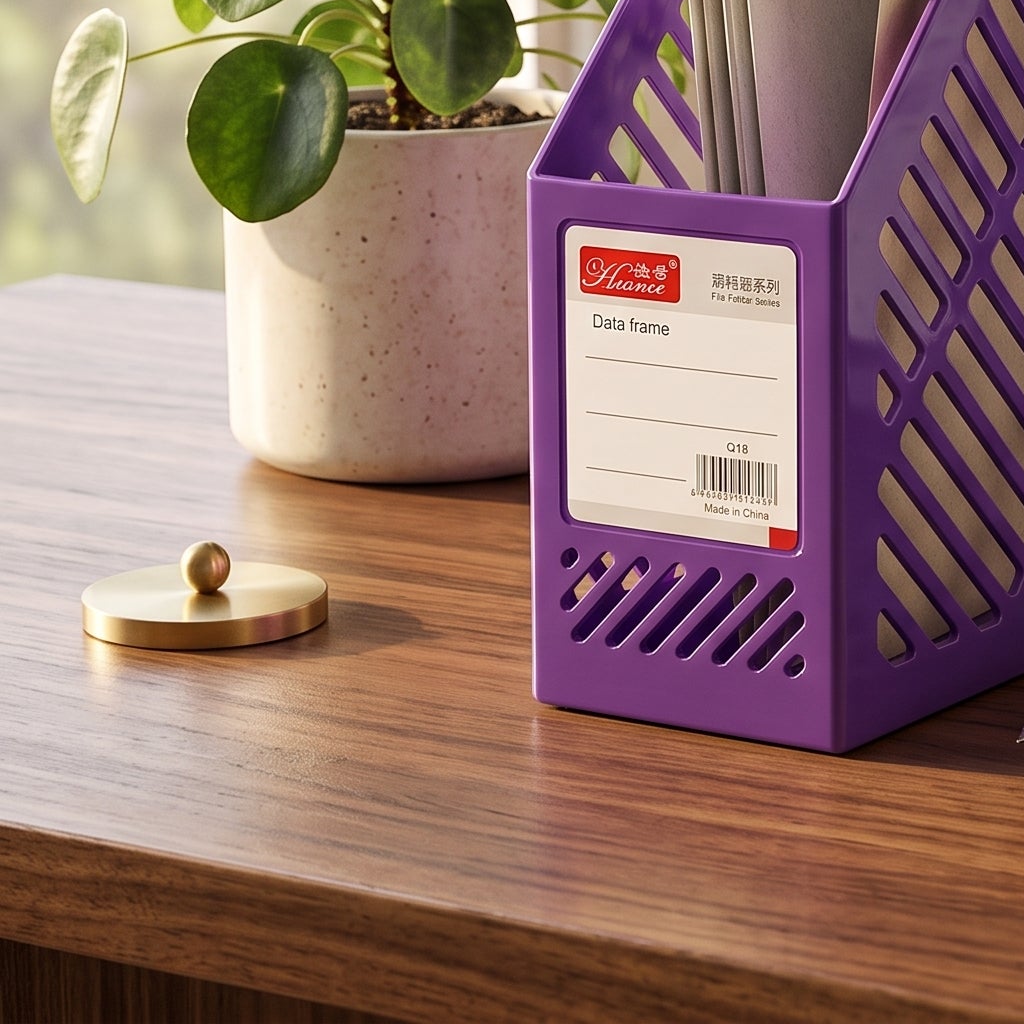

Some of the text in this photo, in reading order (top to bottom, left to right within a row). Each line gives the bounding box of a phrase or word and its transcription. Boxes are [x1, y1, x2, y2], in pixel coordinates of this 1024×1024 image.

[593, 313, 670, 336] Data frame
[726, 442, 749, 455] Q18
[704, 502, 770, 521] Made in China
